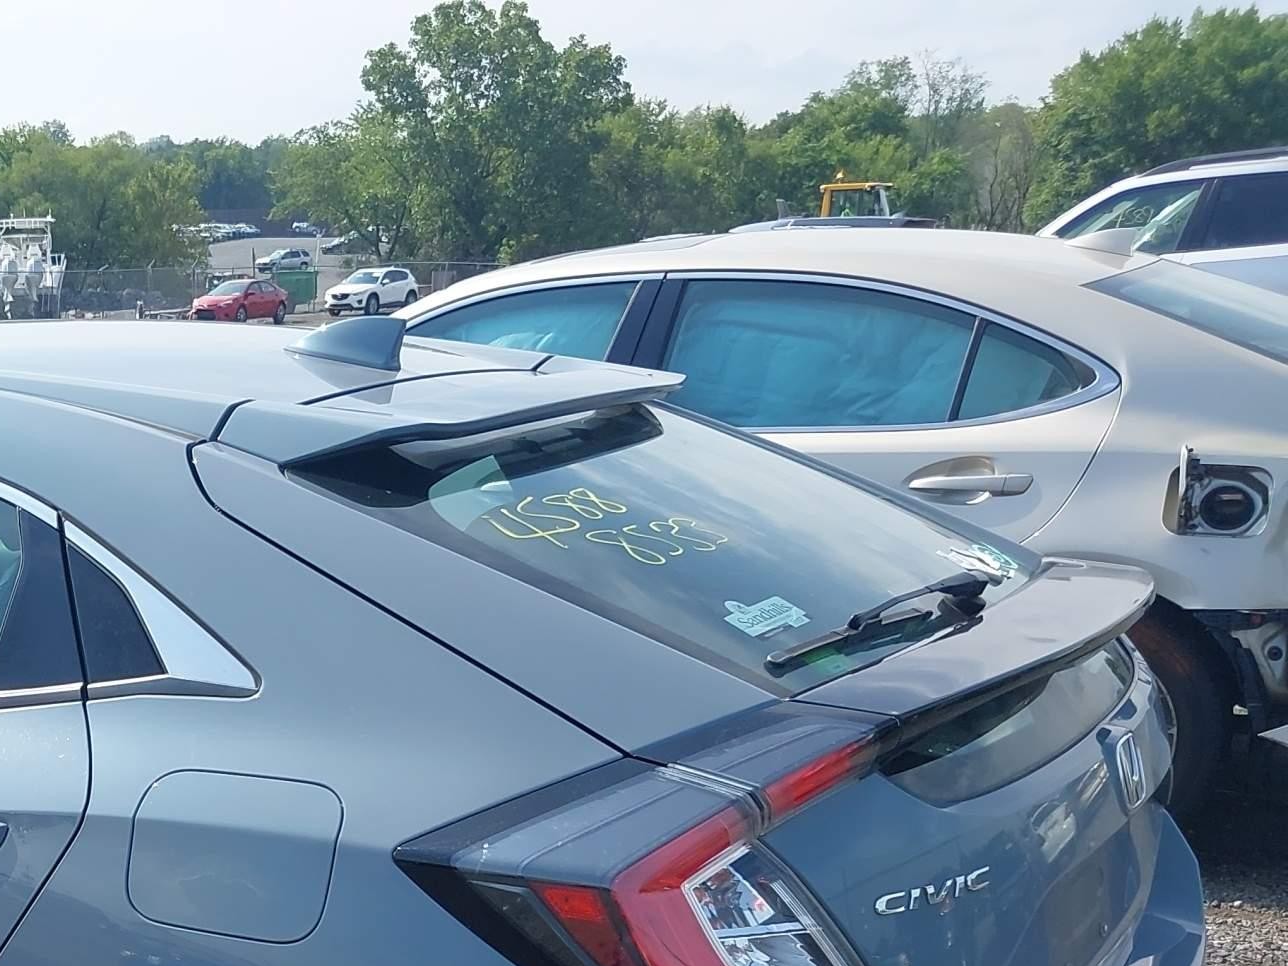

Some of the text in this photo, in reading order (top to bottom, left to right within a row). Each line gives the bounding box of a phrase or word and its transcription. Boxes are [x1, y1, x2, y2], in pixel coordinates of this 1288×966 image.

[481, 488, 627, 549] 4588
[585, 518, 728, 565] 8533
[737, 602, 793, 628] Sandhills
[874, 866, 991, 915] CIVIC
